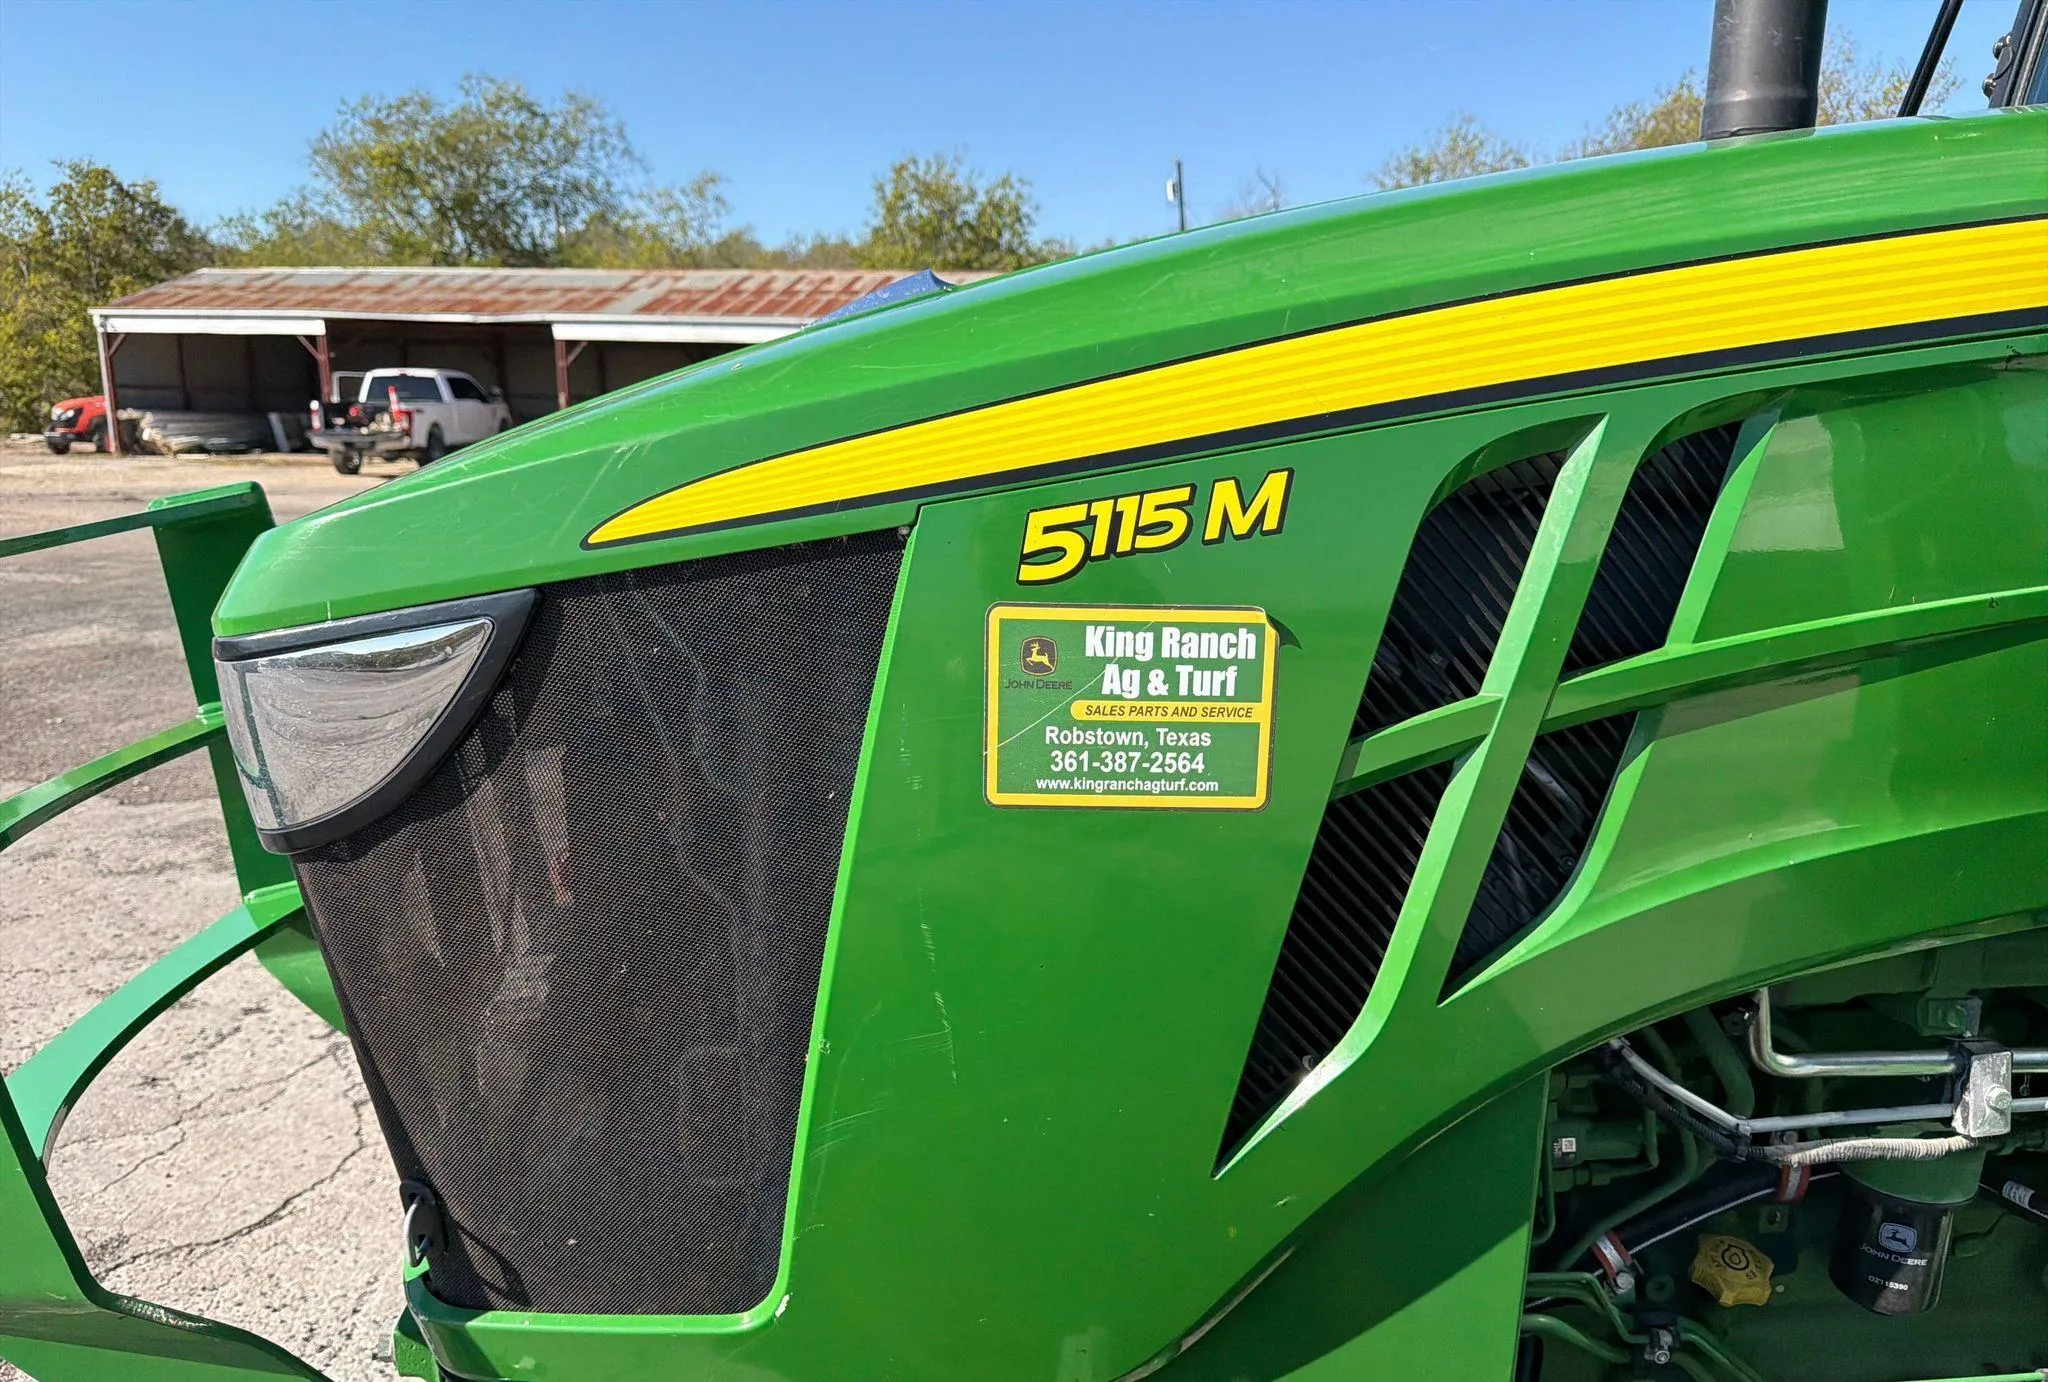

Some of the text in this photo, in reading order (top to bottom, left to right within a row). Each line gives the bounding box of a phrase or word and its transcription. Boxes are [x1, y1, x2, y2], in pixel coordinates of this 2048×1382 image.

[1016, 467, 1295, 585] 5115 M
[1085, 625, 1257, 662] King Ranch
[1004, 678, 1073, 690] JOHN DEERE
[1101, 663, 1238, 699] Ag & Turf
[1085, 704, 1254, 719] SALES PARTS AND SERVICE
[1045, 725, 1212, 750] Robstown, Texas
[1050, 750, 1205, 774] 361-387-2564
[1035, 776, 1219, 794] www.kingranchagturf.com
[1891, 1254, 1929, 1266] DEERE
